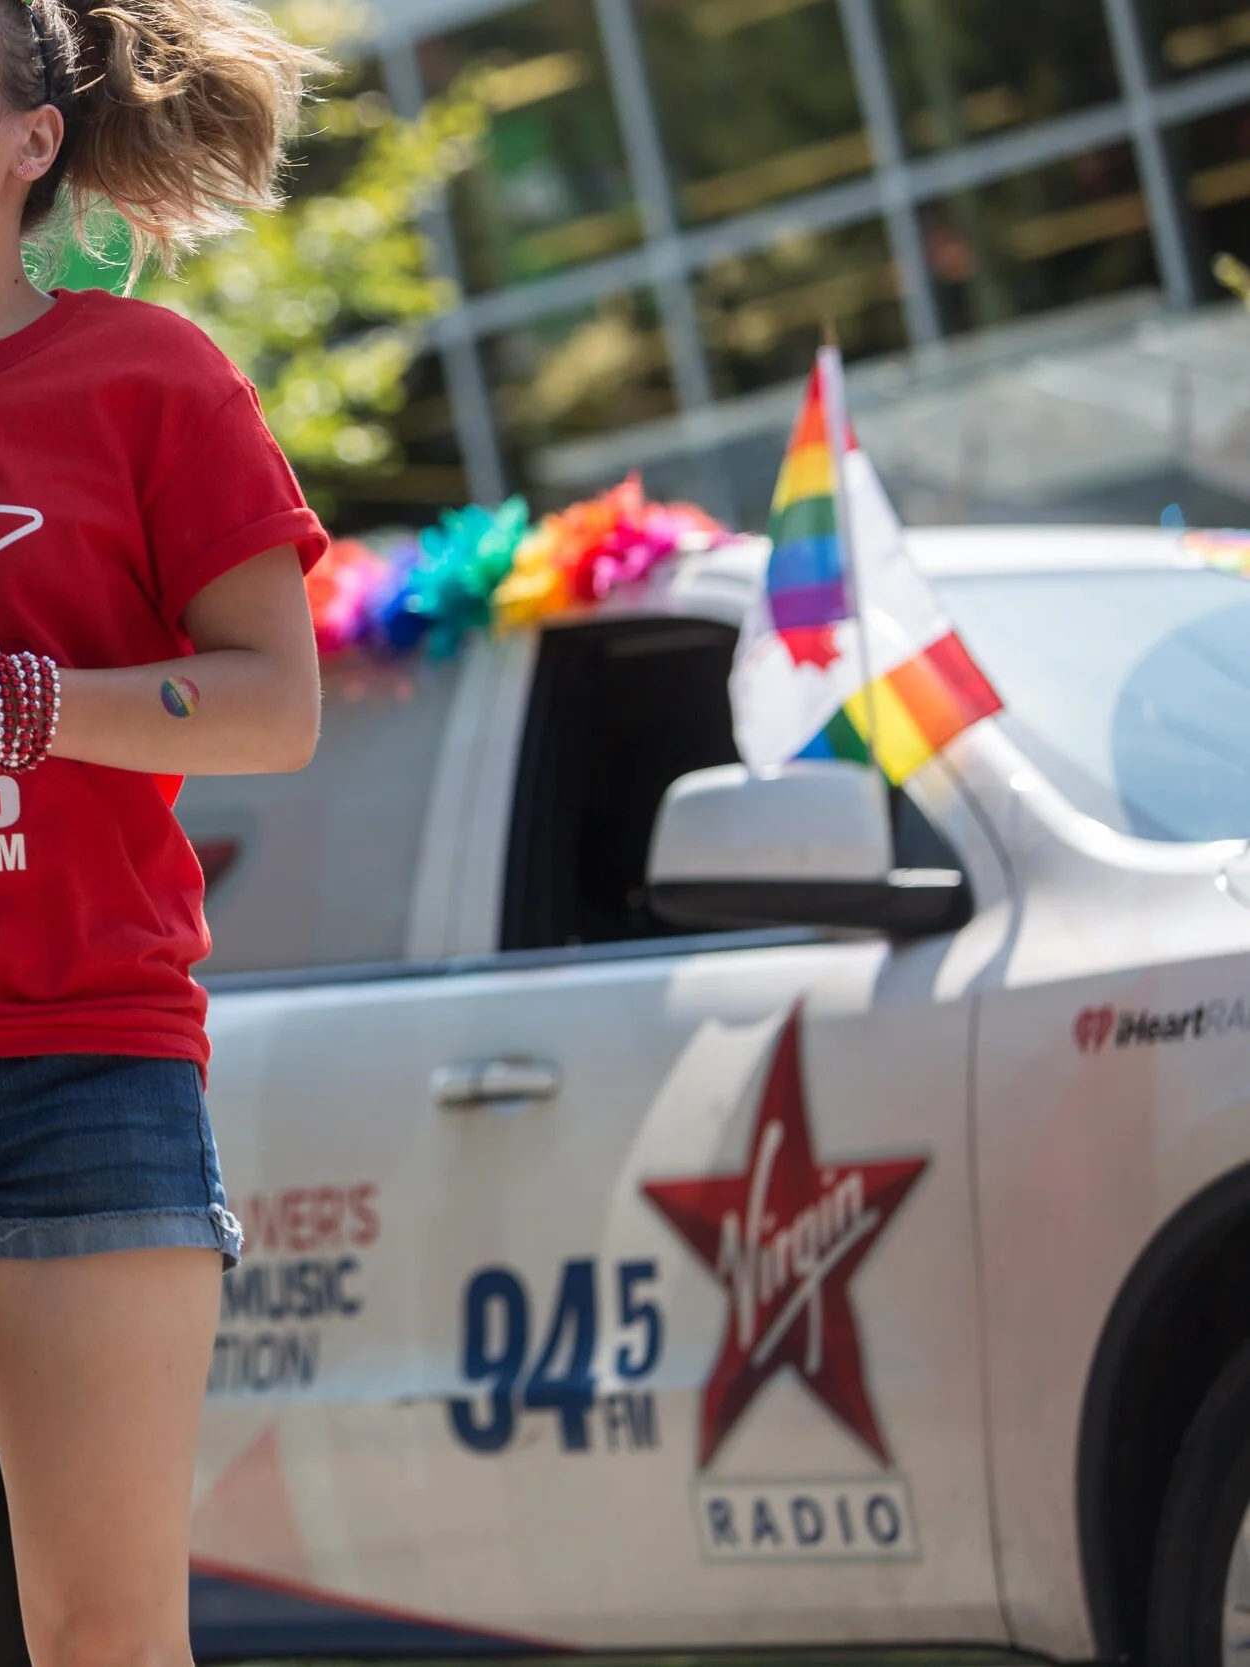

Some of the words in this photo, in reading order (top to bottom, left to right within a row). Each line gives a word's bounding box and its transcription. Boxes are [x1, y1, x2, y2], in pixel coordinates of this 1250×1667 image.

[717, 1120, 882, 1377] Virgin
[223, 1255, 366, 1321] MUSIC
[207, 1329, 322, 1394] TION
[602, 1392, 662, 1453] FM
[705, 1493, 903, 1548] RADIO
